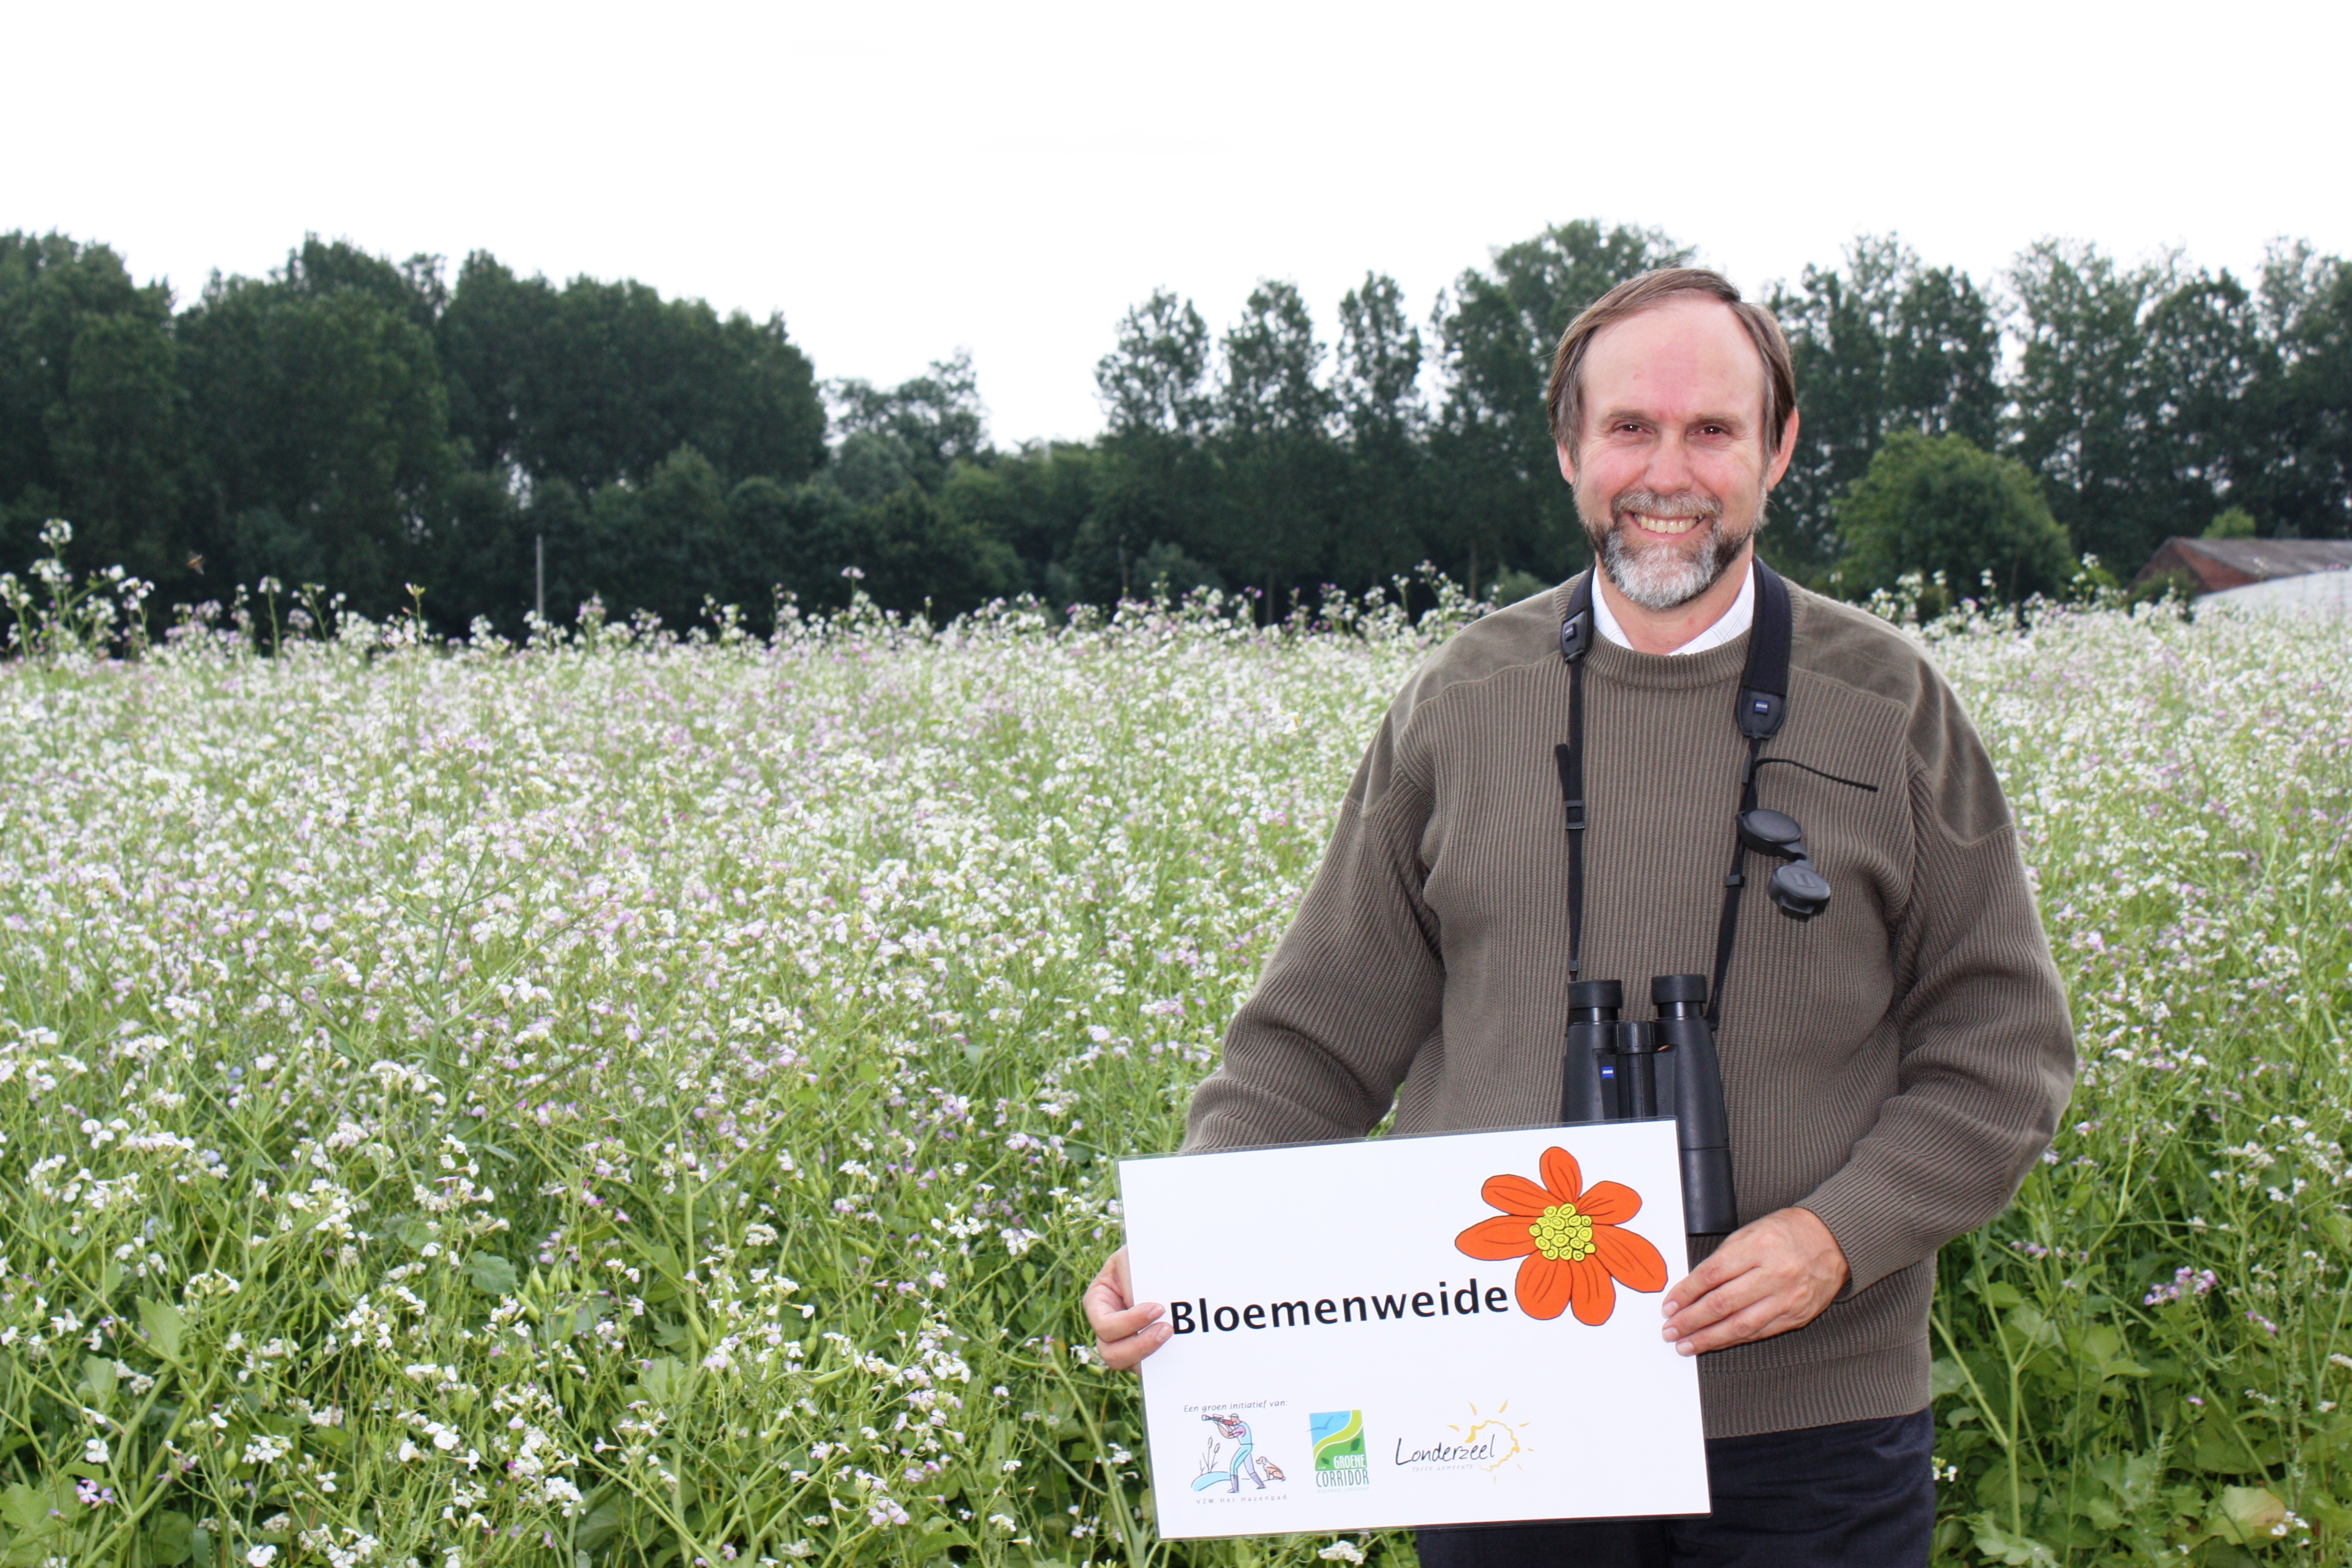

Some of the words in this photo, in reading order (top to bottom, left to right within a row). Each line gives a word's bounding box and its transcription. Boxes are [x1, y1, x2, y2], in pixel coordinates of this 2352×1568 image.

[1170, 1278, 1509, 1335] Bloemenweide
[1202, 1403, 1227, 1413] groen
[1230, 1400, 1267, 1409] initiatief
[1396, 1434, 1495, 1465] Londerzeel
[1333, 1454, 1366, 1469] GROENE
[1316, 1469, 1369, 1488] CORRIDOR
